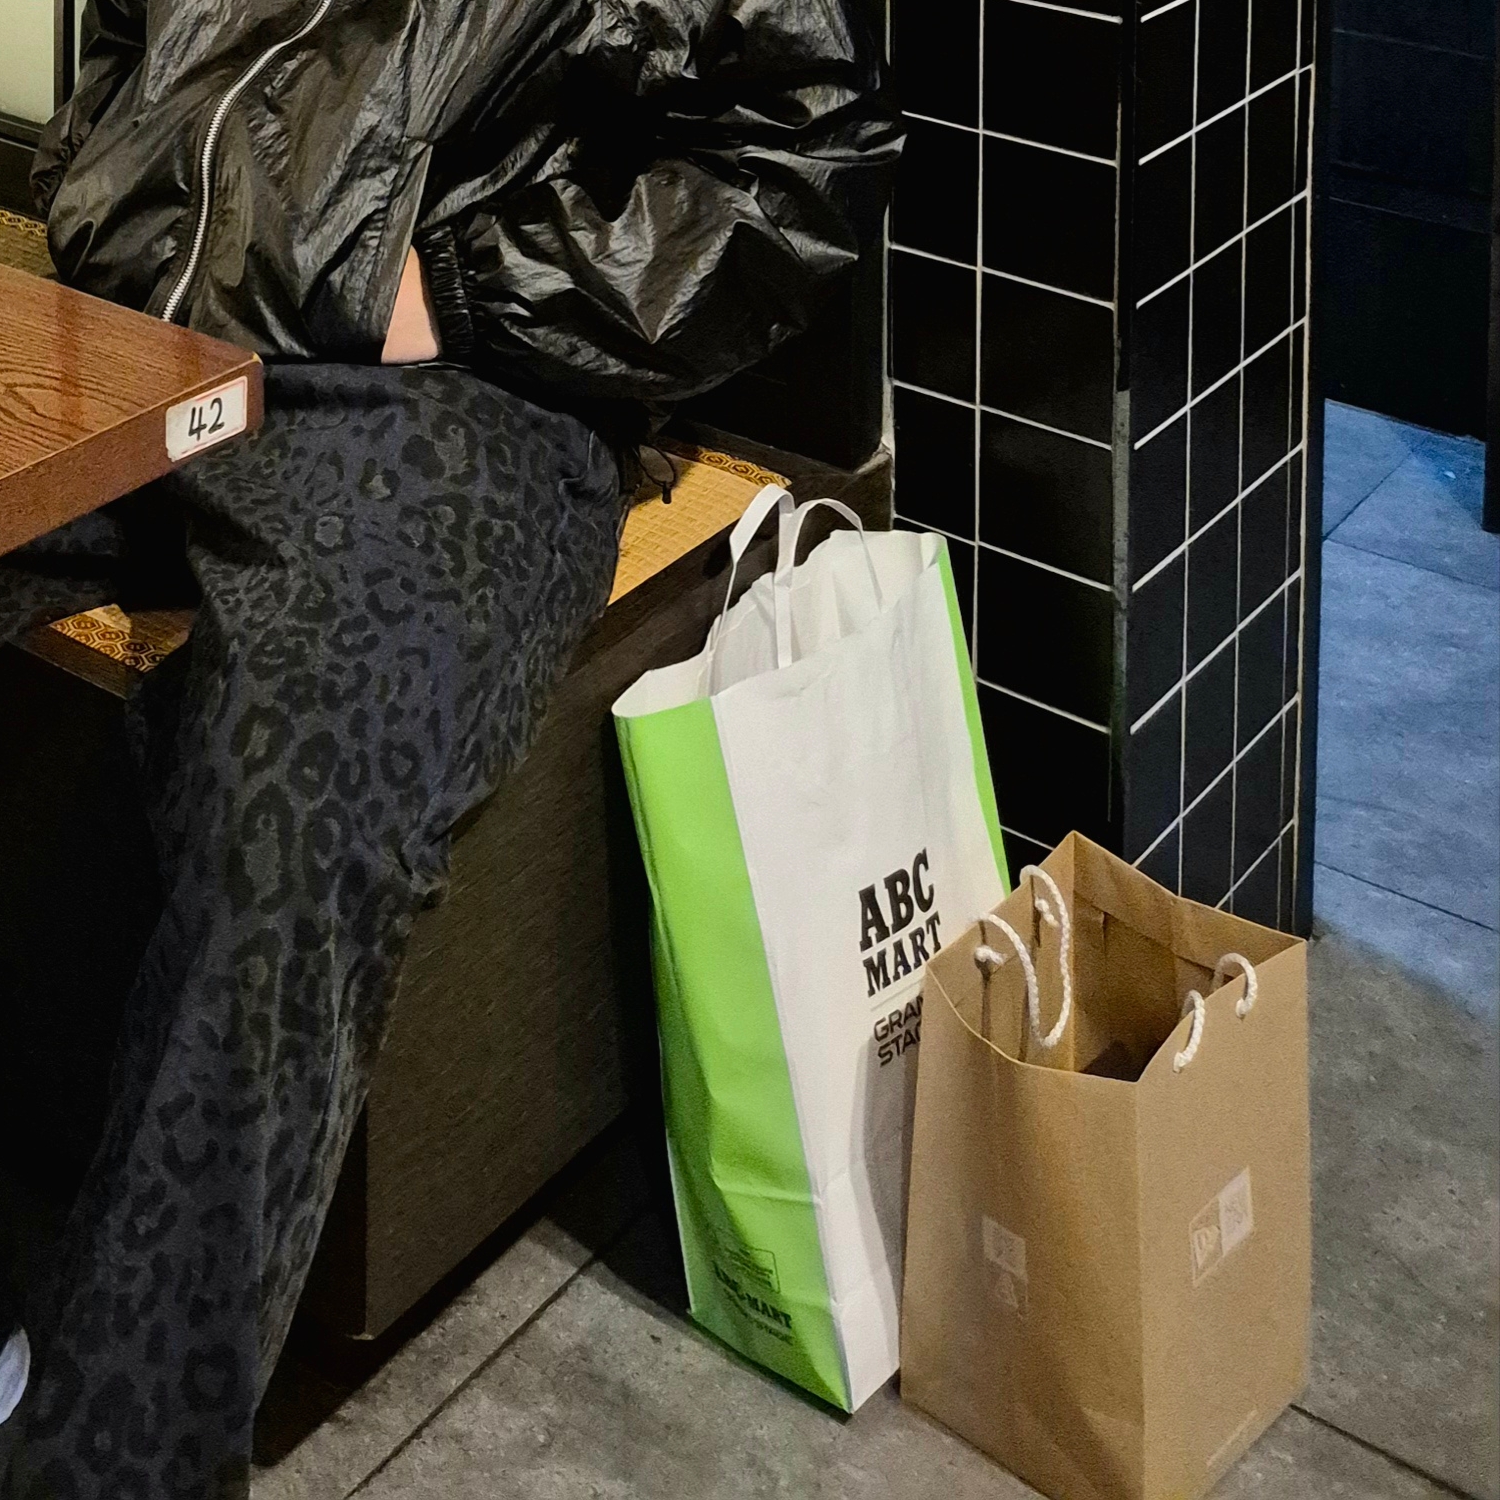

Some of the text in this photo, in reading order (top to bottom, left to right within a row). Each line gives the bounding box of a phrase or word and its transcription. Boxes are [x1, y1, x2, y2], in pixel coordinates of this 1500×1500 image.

[188, 397, 225, 441] 42
[859, 847, 934, 953] ABC
[862, 911, 942, 997] MART
